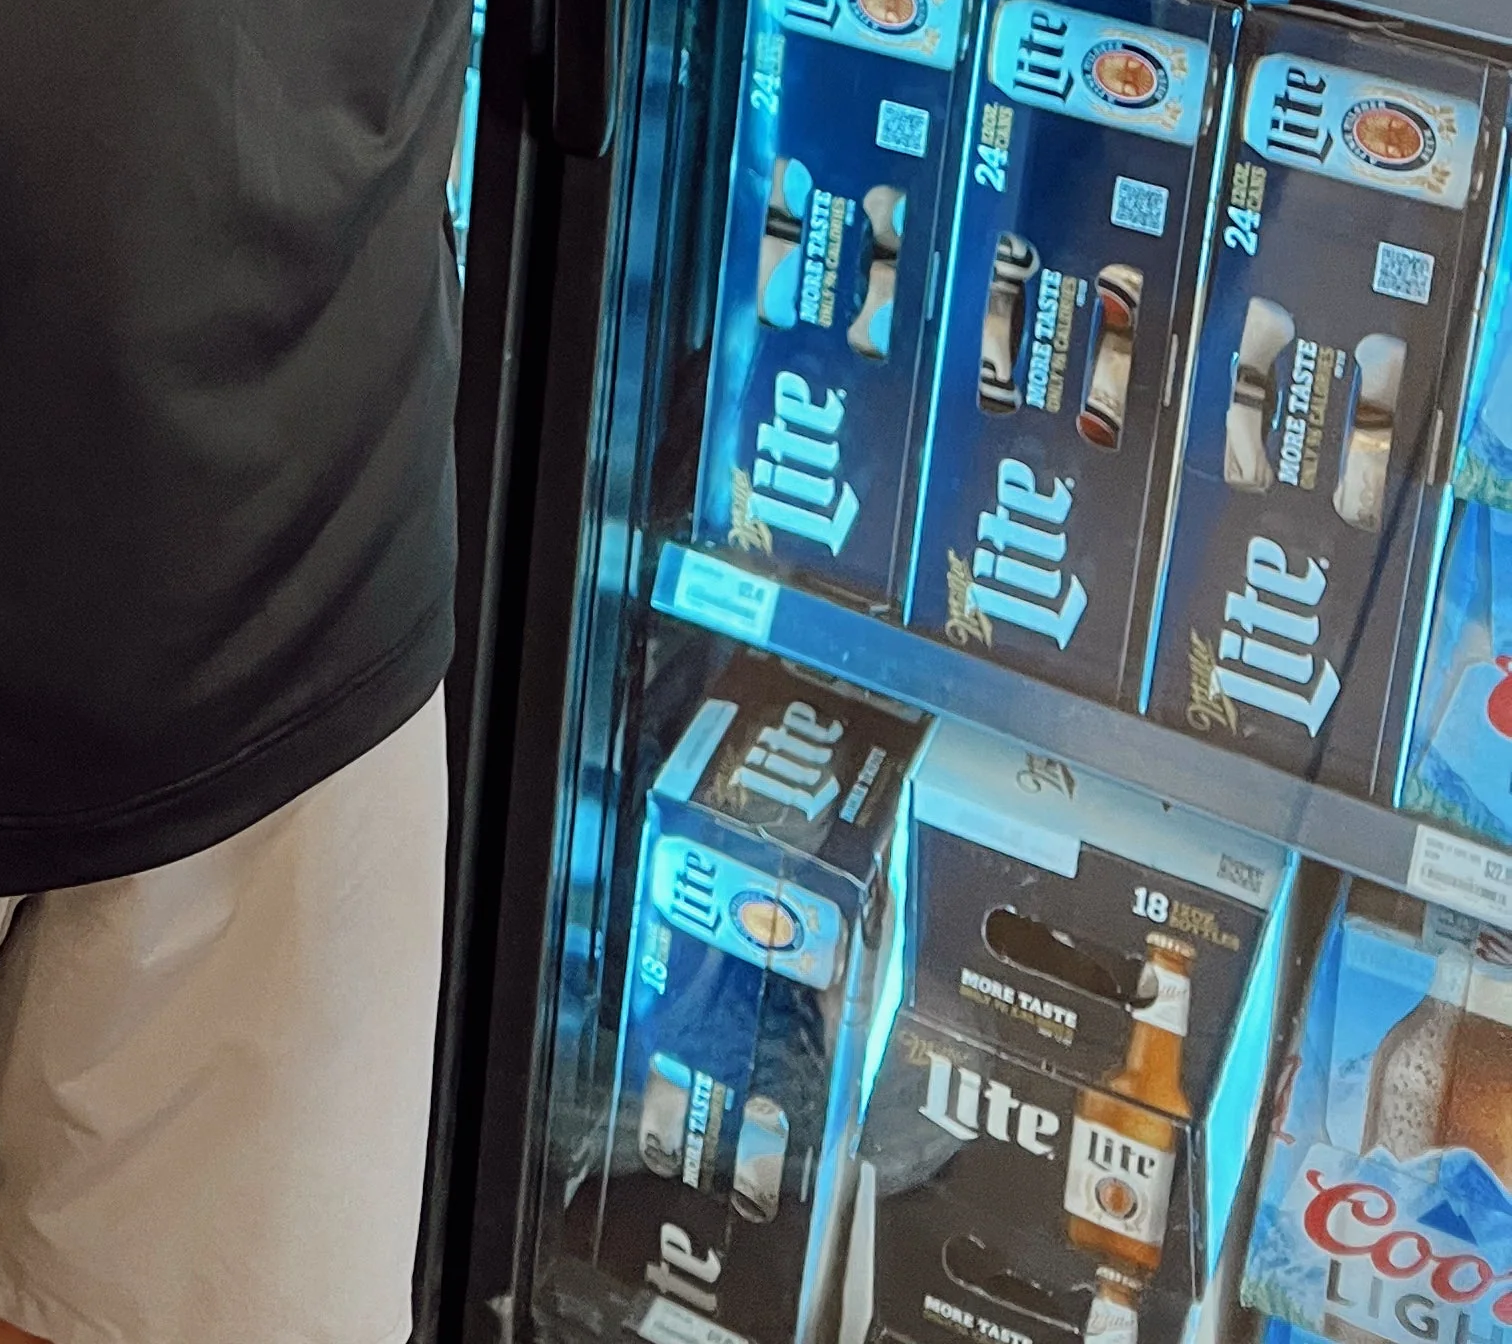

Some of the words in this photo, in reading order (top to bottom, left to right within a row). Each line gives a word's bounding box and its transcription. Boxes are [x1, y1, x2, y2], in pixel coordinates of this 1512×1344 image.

[1013, 9, 1074, 104] Lite
[750, 71, 782, 116] 24
[1266, 65, 1334, 165] Lite
[974, 144, 1010, 194] 24
[807, 188, 832, 259] TASTE
[1223, 205, 1262, 257] 24
[799, 258, 824, 326] MORE
[1035, 267, 1063, 342] TASTE
[1025, 339, 1054, 412] MORE
[1288, 337, 1320, 415] TASTE
[746, 370, 861, 558] Lite
[1278, 417, 1307, 487] MORE
[965, 457, 1088, 652] Lite
[1209, 535, 1342, 740] Lite
[727, 700, 845, 823] Lite
[671, 849, 722, 935] Lite
[1132, 886, 1171, 925] 18
[640, 954, 669, 996] 18
[959, 966, 1016, 1006] MORE
[1017, 990, 1079, 1030] TASTE
[917, 1050, 1061, 1162] Lite
[1087, 1129, 1157, 1180] Lite
[924, 1295, 977, 1330] MORE
